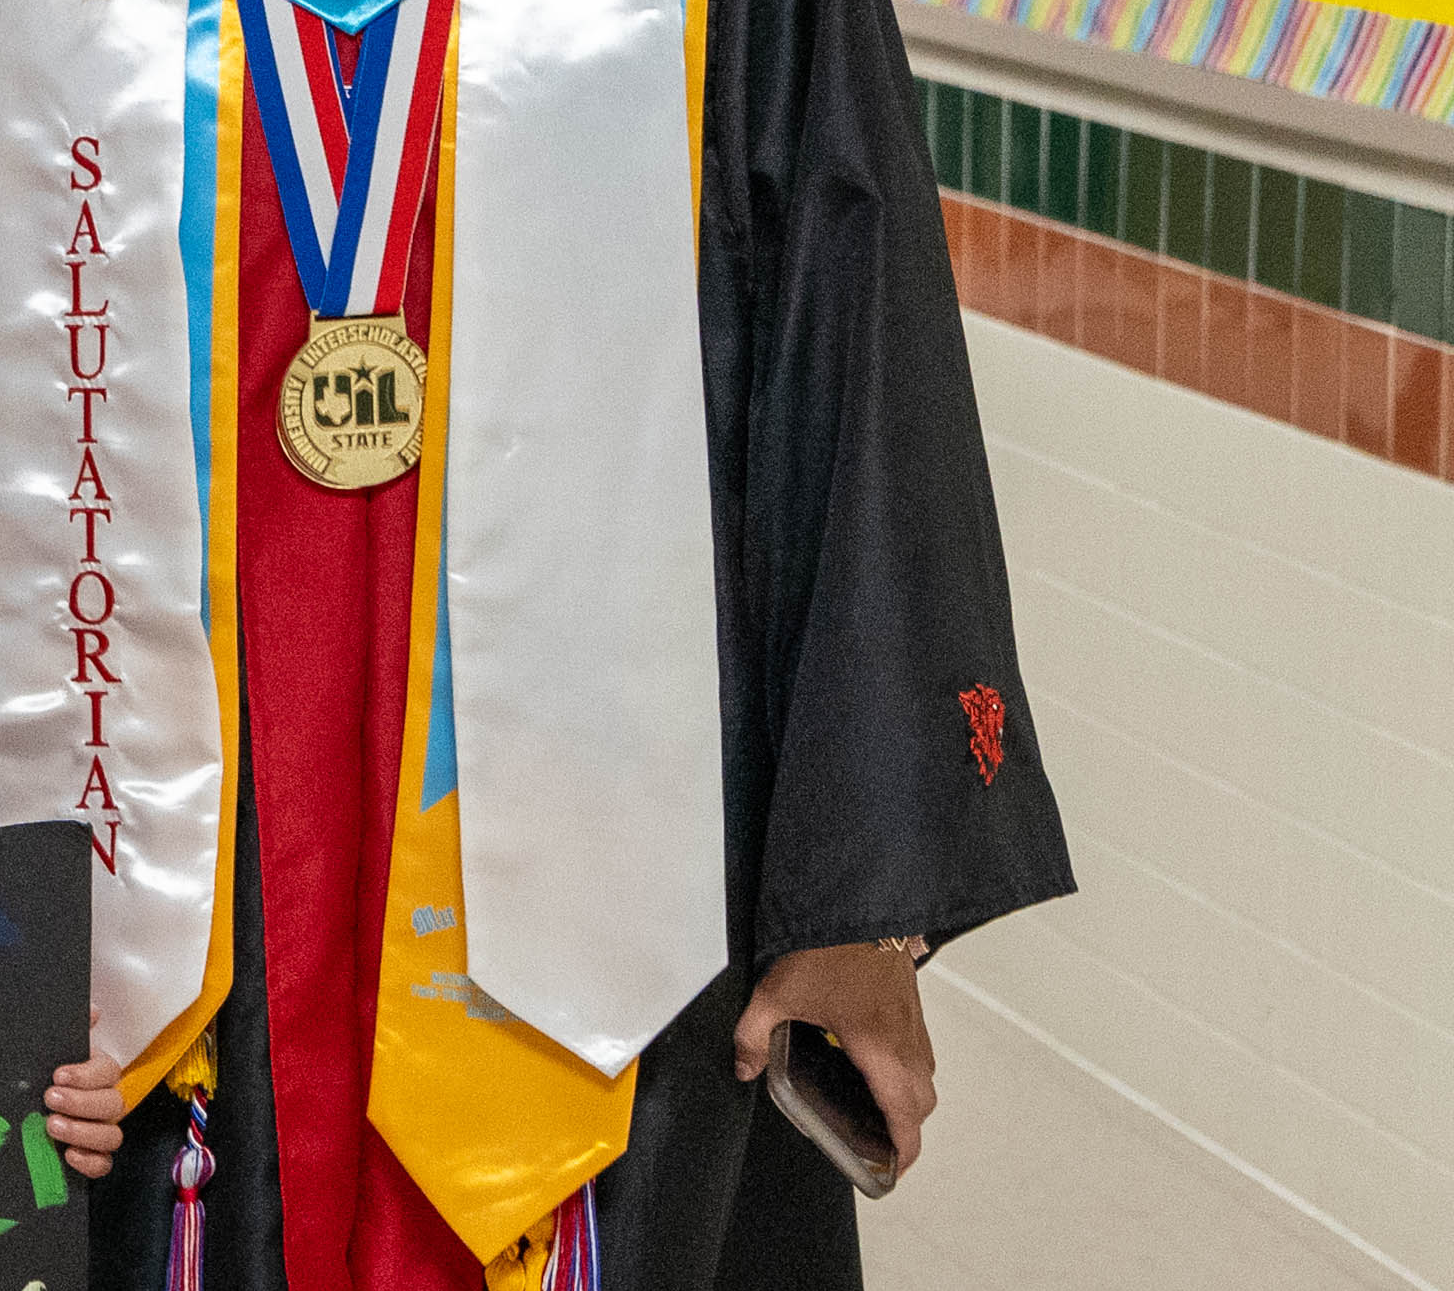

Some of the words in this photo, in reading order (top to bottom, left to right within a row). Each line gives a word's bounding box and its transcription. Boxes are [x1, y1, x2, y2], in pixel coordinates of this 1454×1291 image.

[301, 323, 428, 384] INTERSCHOLASTI
[331, 433, 393, 450] STATE
[64, 136, 122, 876] SALUTATORIAN
